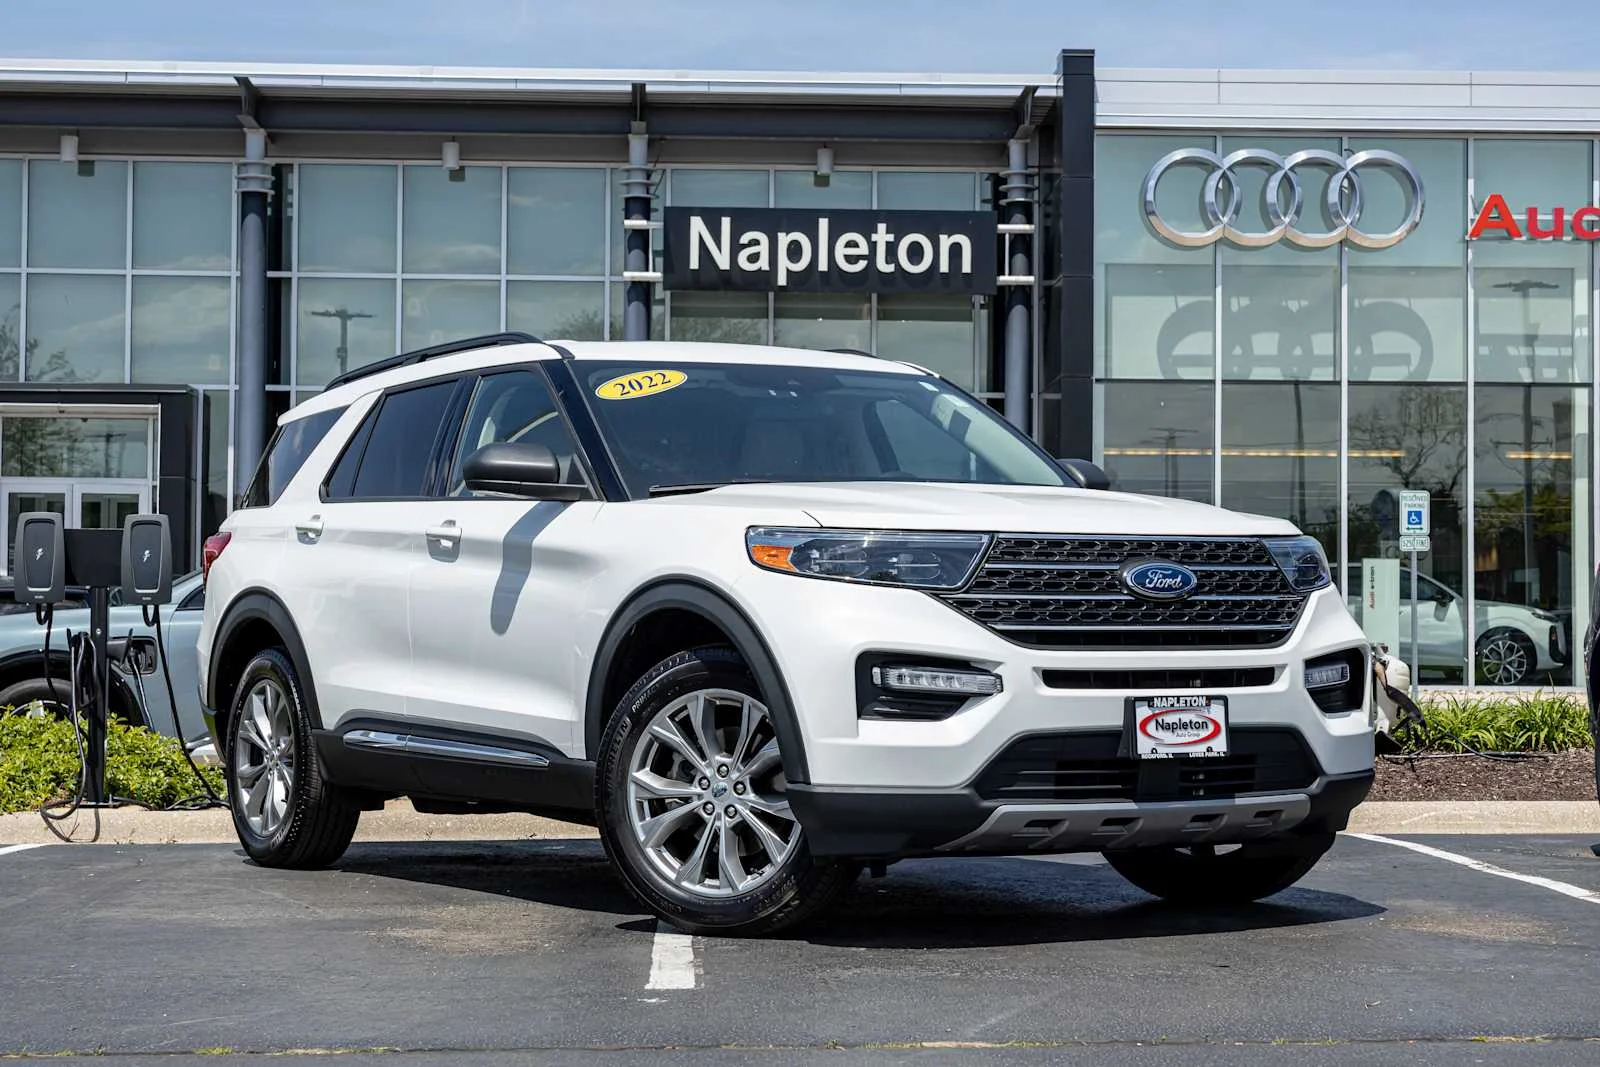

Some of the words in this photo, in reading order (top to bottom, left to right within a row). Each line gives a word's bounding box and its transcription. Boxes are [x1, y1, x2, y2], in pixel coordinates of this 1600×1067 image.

[688, 215, 973, 287] Napleton
[613, 372, 671, 396] 2022
[1145, 569, 1183, 589] Ford
[1153, 696, 1206, 708] NAPLETON
[1155, 717, 1209, 733] Napleton
